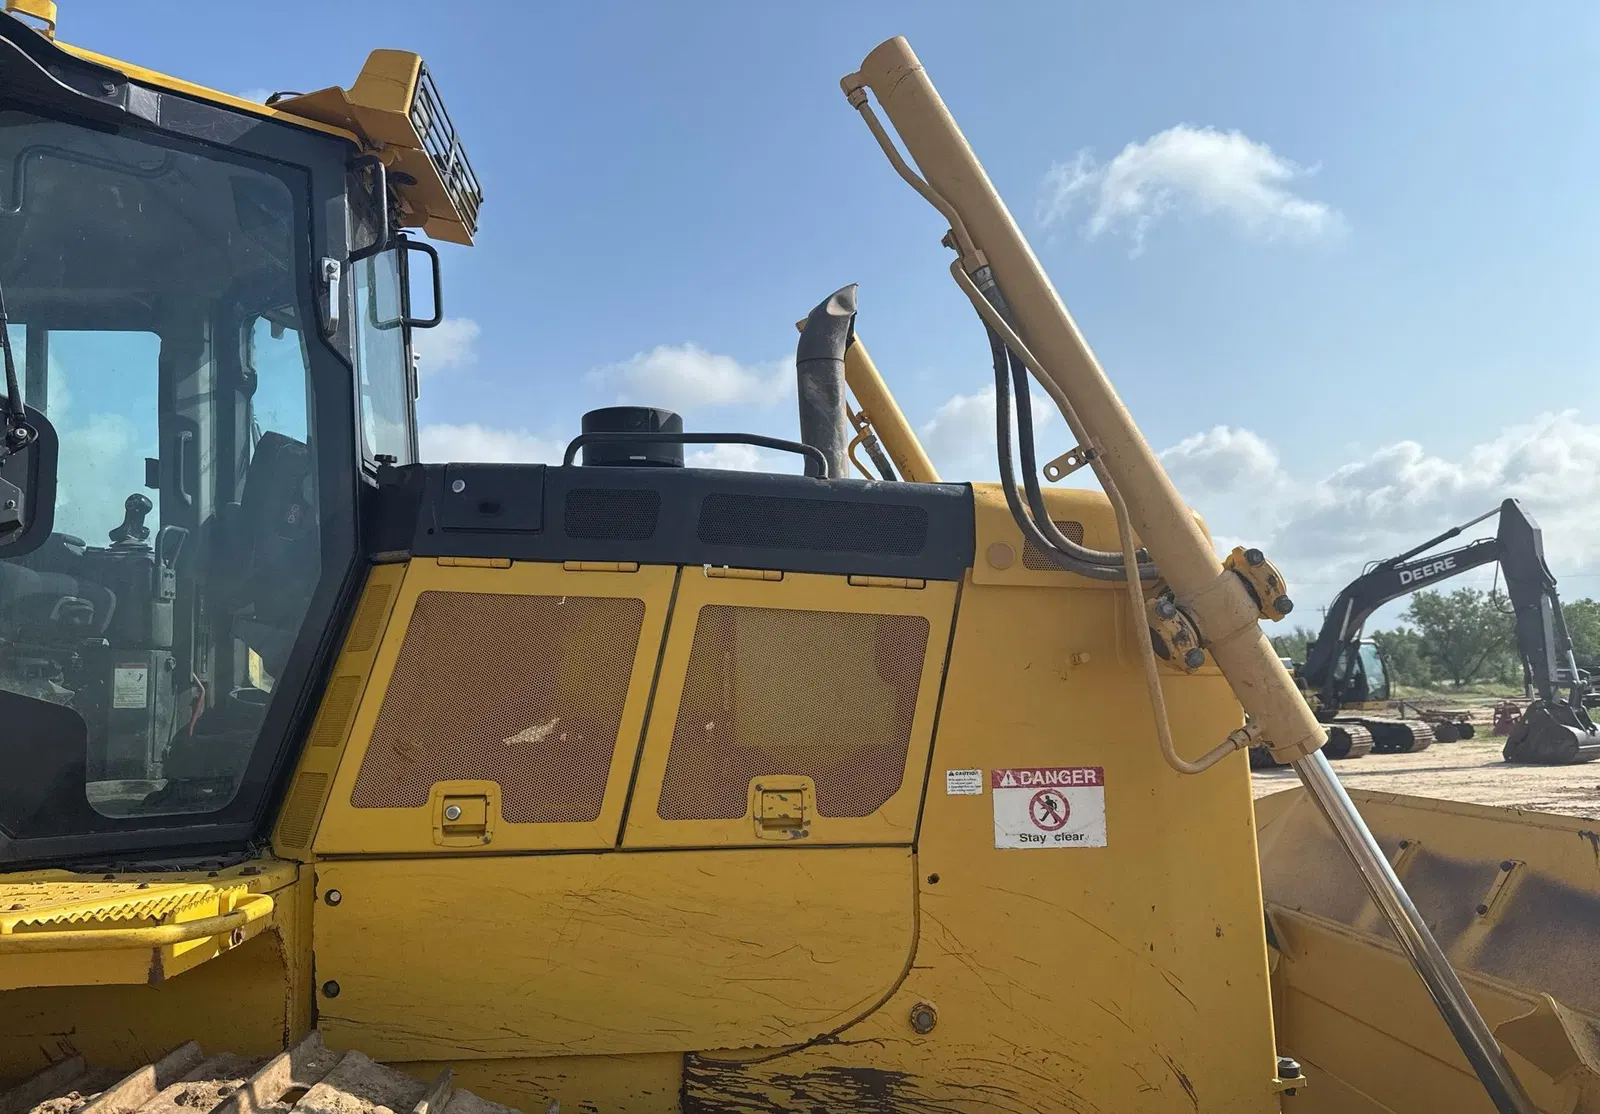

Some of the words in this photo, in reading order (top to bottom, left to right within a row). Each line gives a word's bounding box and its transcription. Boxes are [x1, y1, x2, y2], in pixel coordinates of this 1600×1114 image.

[1399, 556, 1456, 585] DEERE
[1020, 769, 1096, 785] DANGER
[1019, 832, 1047, 844] Stay
[1054, 831, 1085, 842] clear
